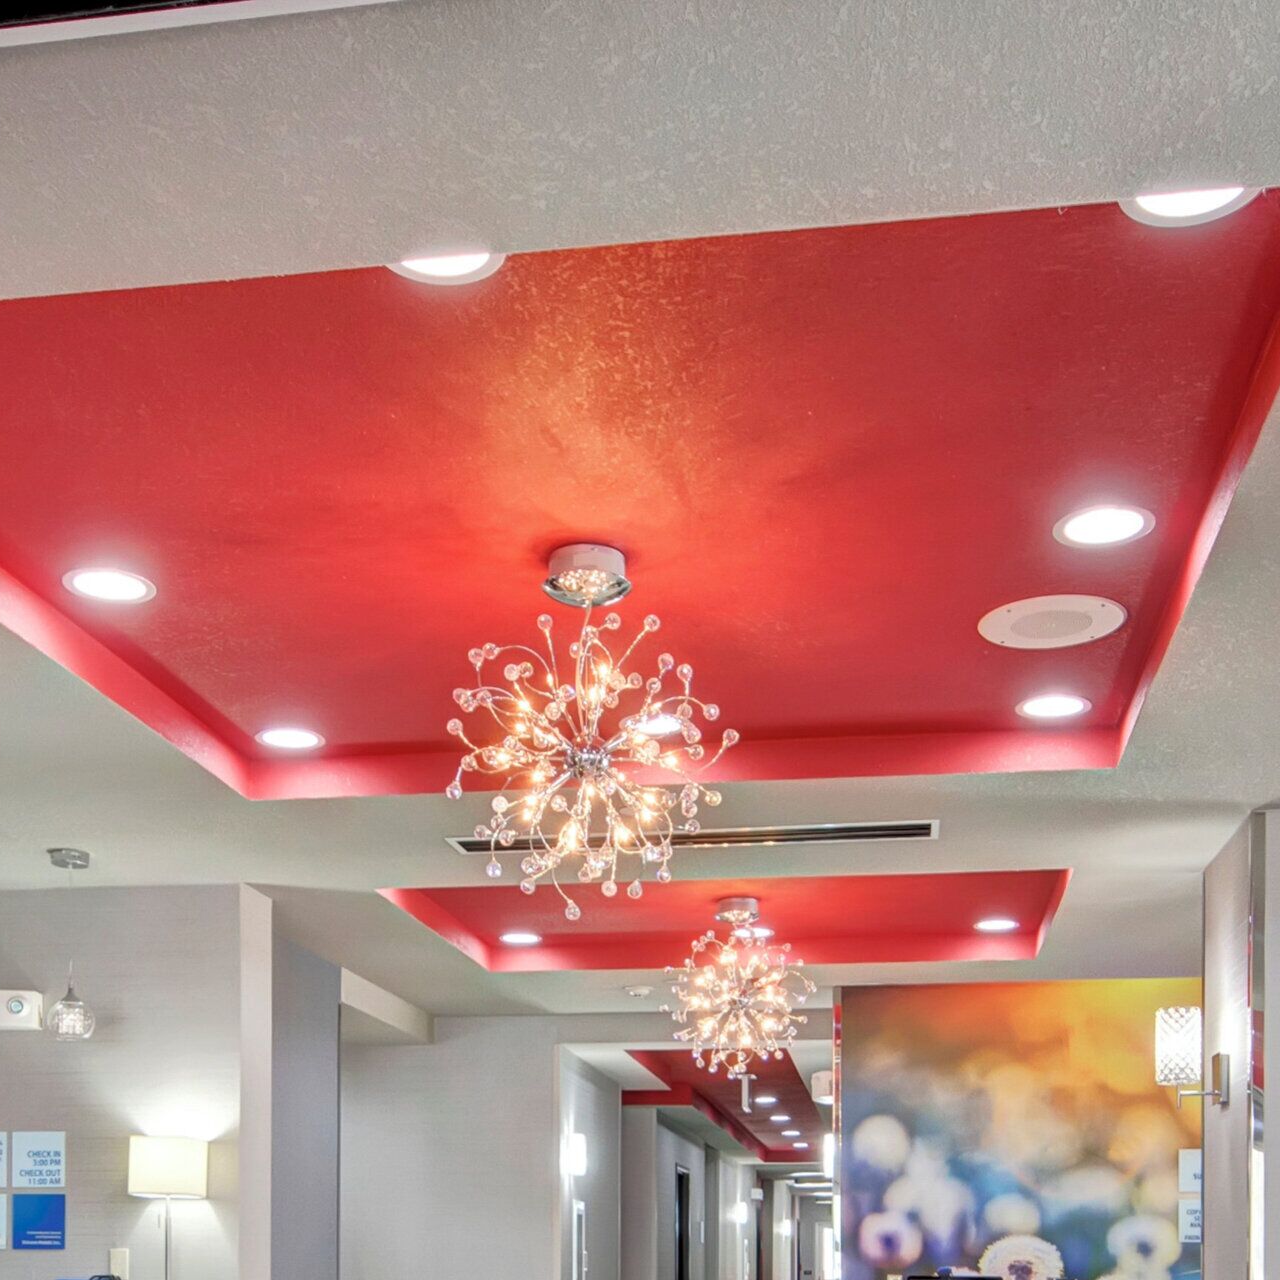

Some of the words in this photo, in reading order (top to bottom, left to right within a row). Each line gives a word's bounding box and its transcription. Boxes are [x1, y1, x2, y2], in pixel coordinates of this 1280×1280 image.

[27, 1150, 51, 1158] CHECK
[53, 1150, 61, 1158] IN
[19, 1169, 44, 1177] CHECK
[45, 1169, 61, 1177] OUT
